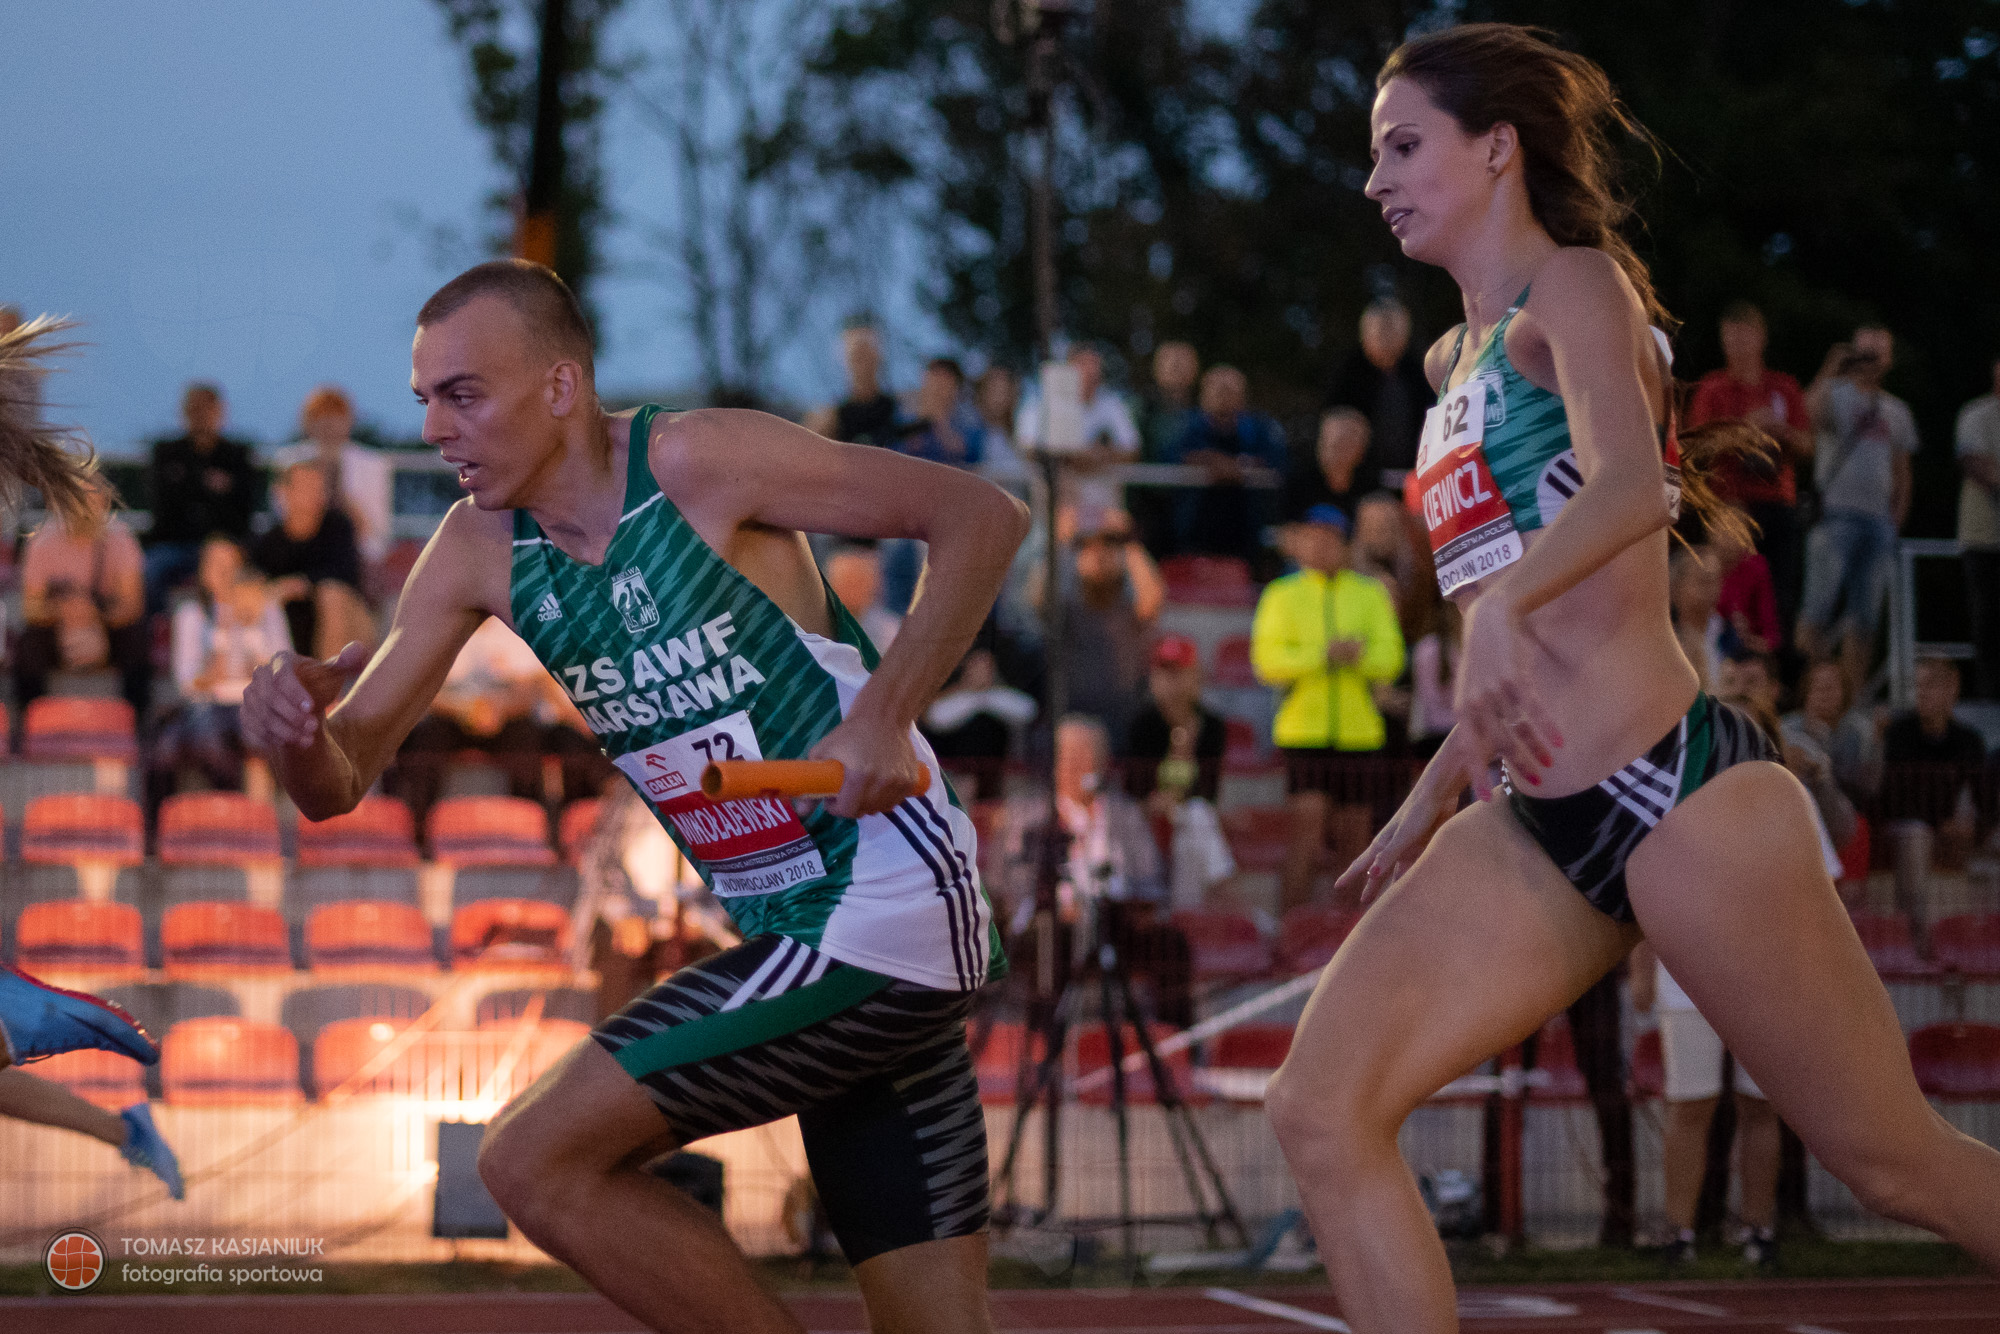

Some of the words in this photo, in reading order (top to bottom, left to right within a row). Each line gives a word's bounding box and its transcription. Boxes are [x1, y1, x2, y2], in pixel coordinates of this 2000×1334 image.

[1443, 395, 1469, 442] 62
[1478, 544, 1511, 571] 2018
[633, 611, 736, 689] AWF
[691, 732, 746, 762] 72
[648, 773, 685, 793] ORLEN
[786, 860, 816, 882] 2018
